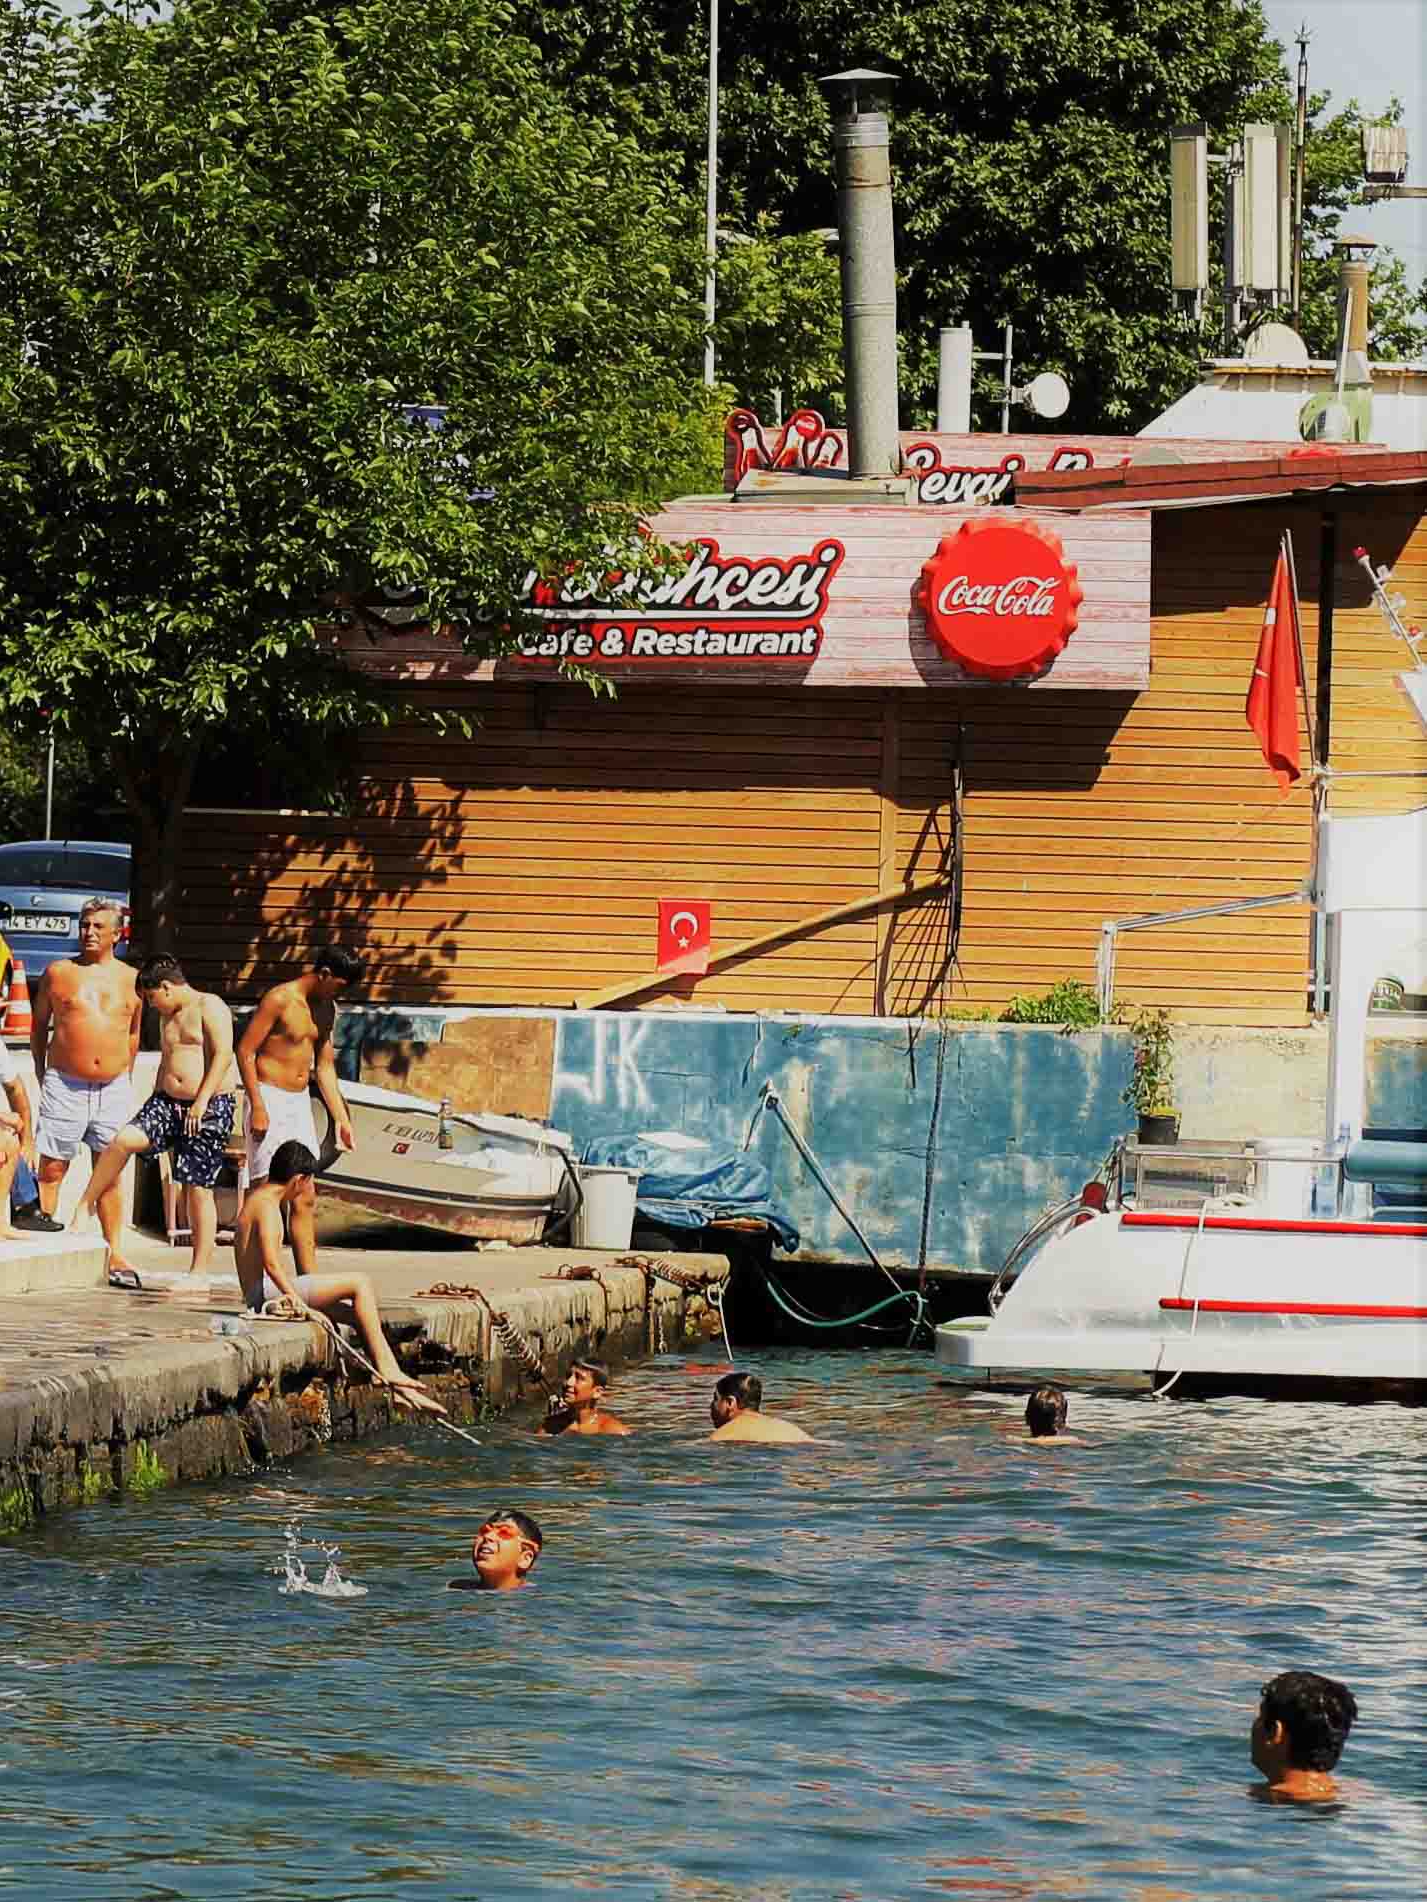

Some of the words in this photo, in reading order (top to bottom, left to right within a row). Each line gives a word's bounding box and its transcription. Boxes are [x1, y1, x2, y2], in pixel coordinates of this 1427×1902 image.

[938, 575, 1061, 616] Coca-Cola
[600, 628, 624, 655] &
[632, 628, 817, 655] Restaurant
